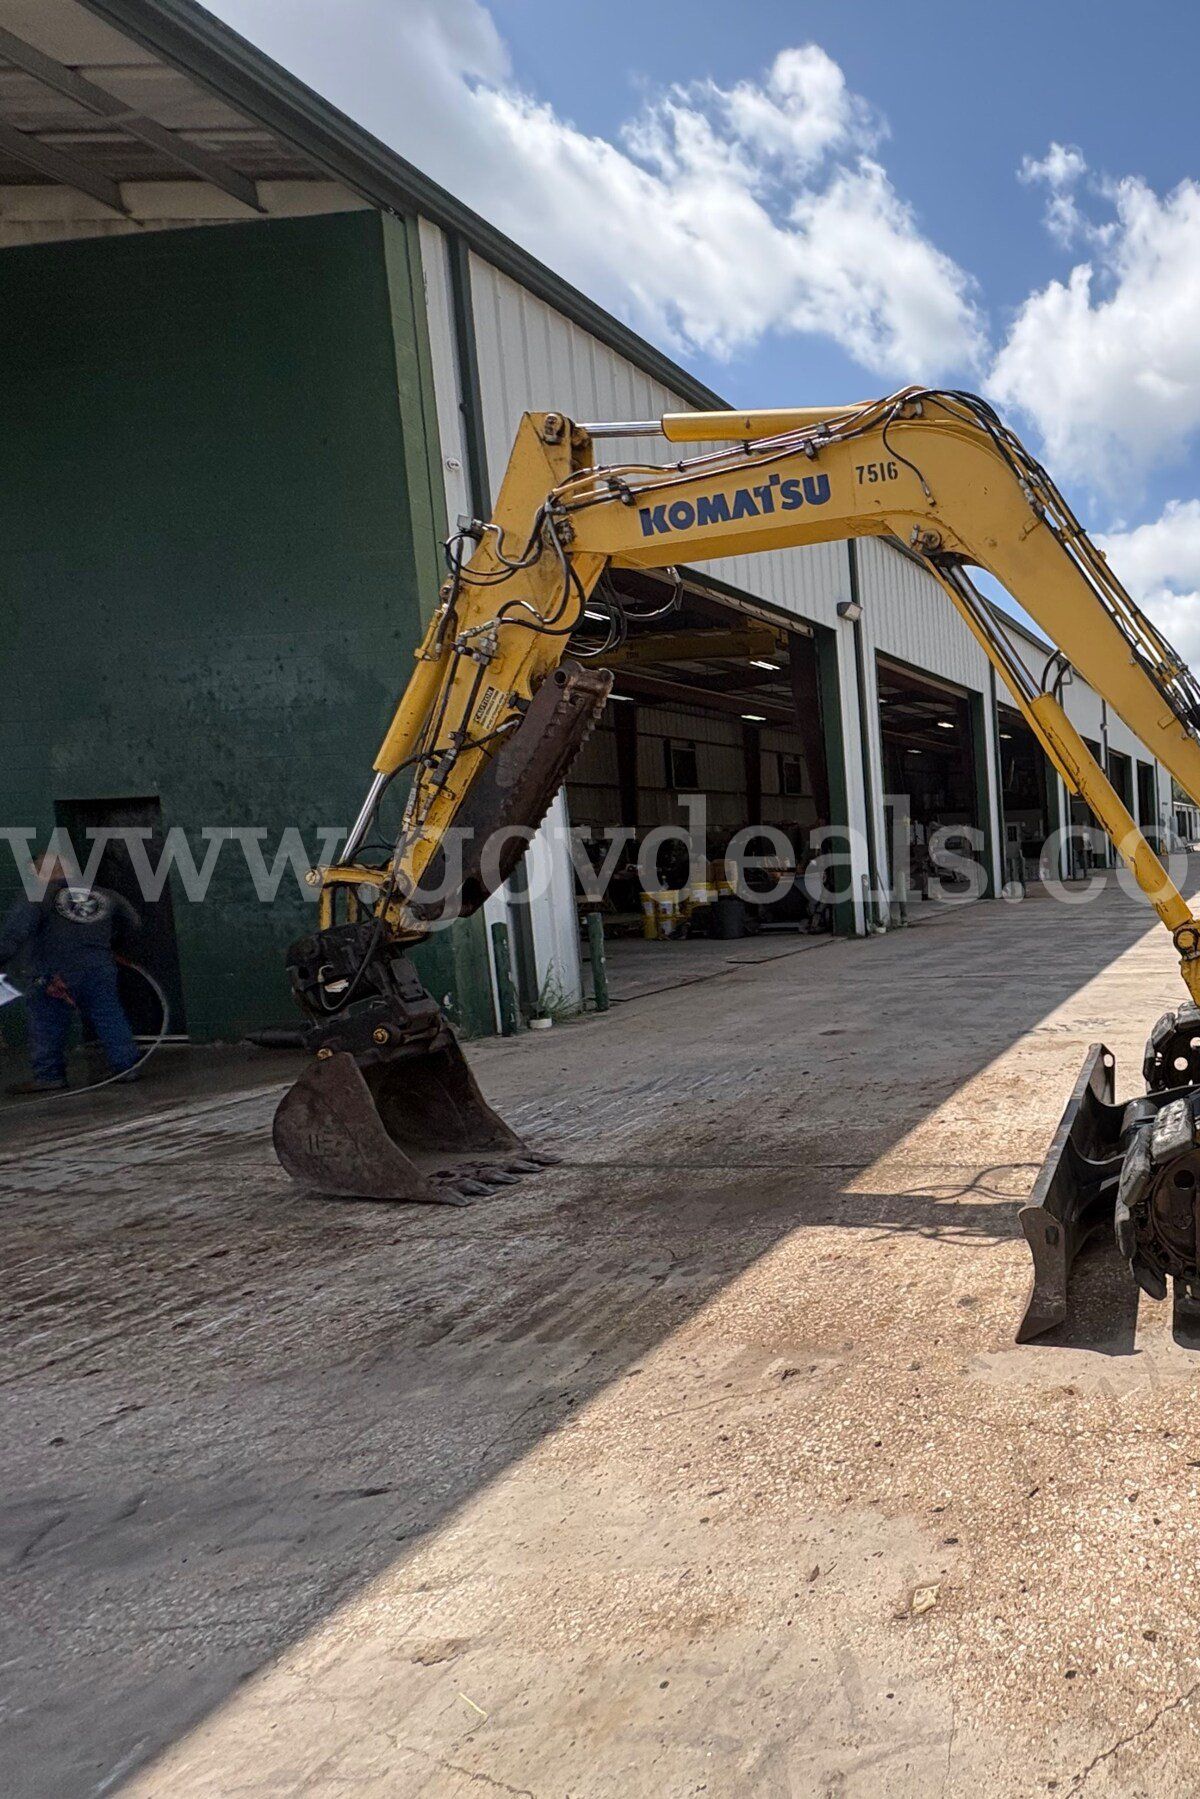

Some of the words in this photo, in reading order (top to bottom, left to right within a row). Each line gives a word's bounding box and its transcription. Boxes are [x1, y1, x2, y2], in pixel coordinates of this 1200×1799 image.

[855, 461, 899, 485] 7516
[638, 473, 831, 537] KOMATSU
[474, 688, 495, 723] CAUTION
